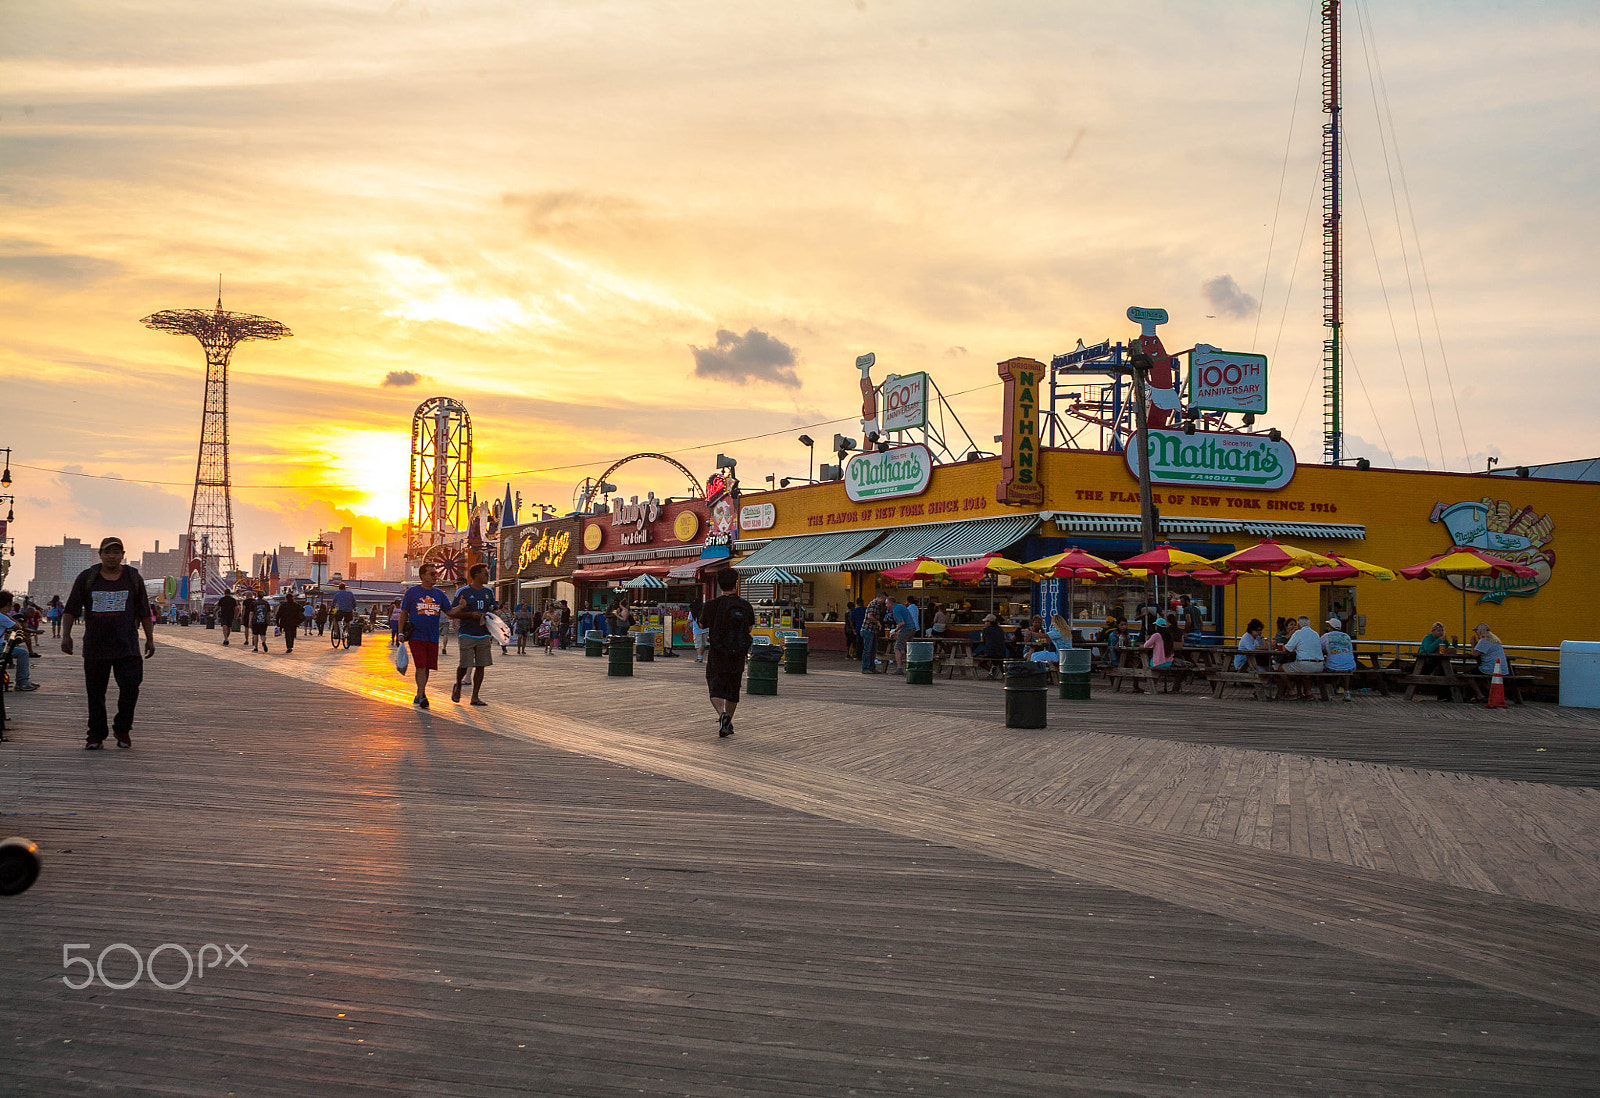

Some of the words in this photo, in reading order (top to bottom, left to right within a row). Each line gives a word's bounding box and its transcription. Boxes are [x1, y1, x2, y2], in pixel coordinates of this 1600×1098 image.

[1012, 361, 1042, 371] ORIGINAL
[1198, 363, 1260, 388] 100TH
[886, 380, 920, 414] 100TH
[1198, 384, 1261, 398] ANNIVERSARY
[1019, 372, 1033, 483] NATHANS
[1148, 432, 1278, 473] Nathan's
[1223, 440, 1239, 448] Since
[851, 452, 922, 487] Nathan's
[1190, 474, 1237, 482] FAMOUS
[874, 486, 898, 494] FAMOUS
[611, 491, 660, 530] Ruby's
[1075, 489, 1104, 501] THE
[1110, 491, 1162, 504] FLAVR
[1168, 494, 1184, 505] OF
[1190, 496, 1221, 507] NEW
[1226, 497, 1262, 510] YORK
[1266, 500, 1305, 512] SINCE
[1310, 502, 1338, 513] 1916
[807, 515, 824, 526] THE
[825, 511, 857, 525] FLAVOR
[860, 509, 872, 521] OF
[875, 506, 896, 520] NEW
[898, 503, 924, 517] YORK
[928, 499, 959, 515] SINCE
[962, 497, 987, 511] 1916
[620, 533, 629, 545] Bar
[634, 529, 647, 543] Grill
[704, 536, 716, 546] GIFT
[716, 534, 729, 545] SHOP
[477, 599, 484, 610] 10
